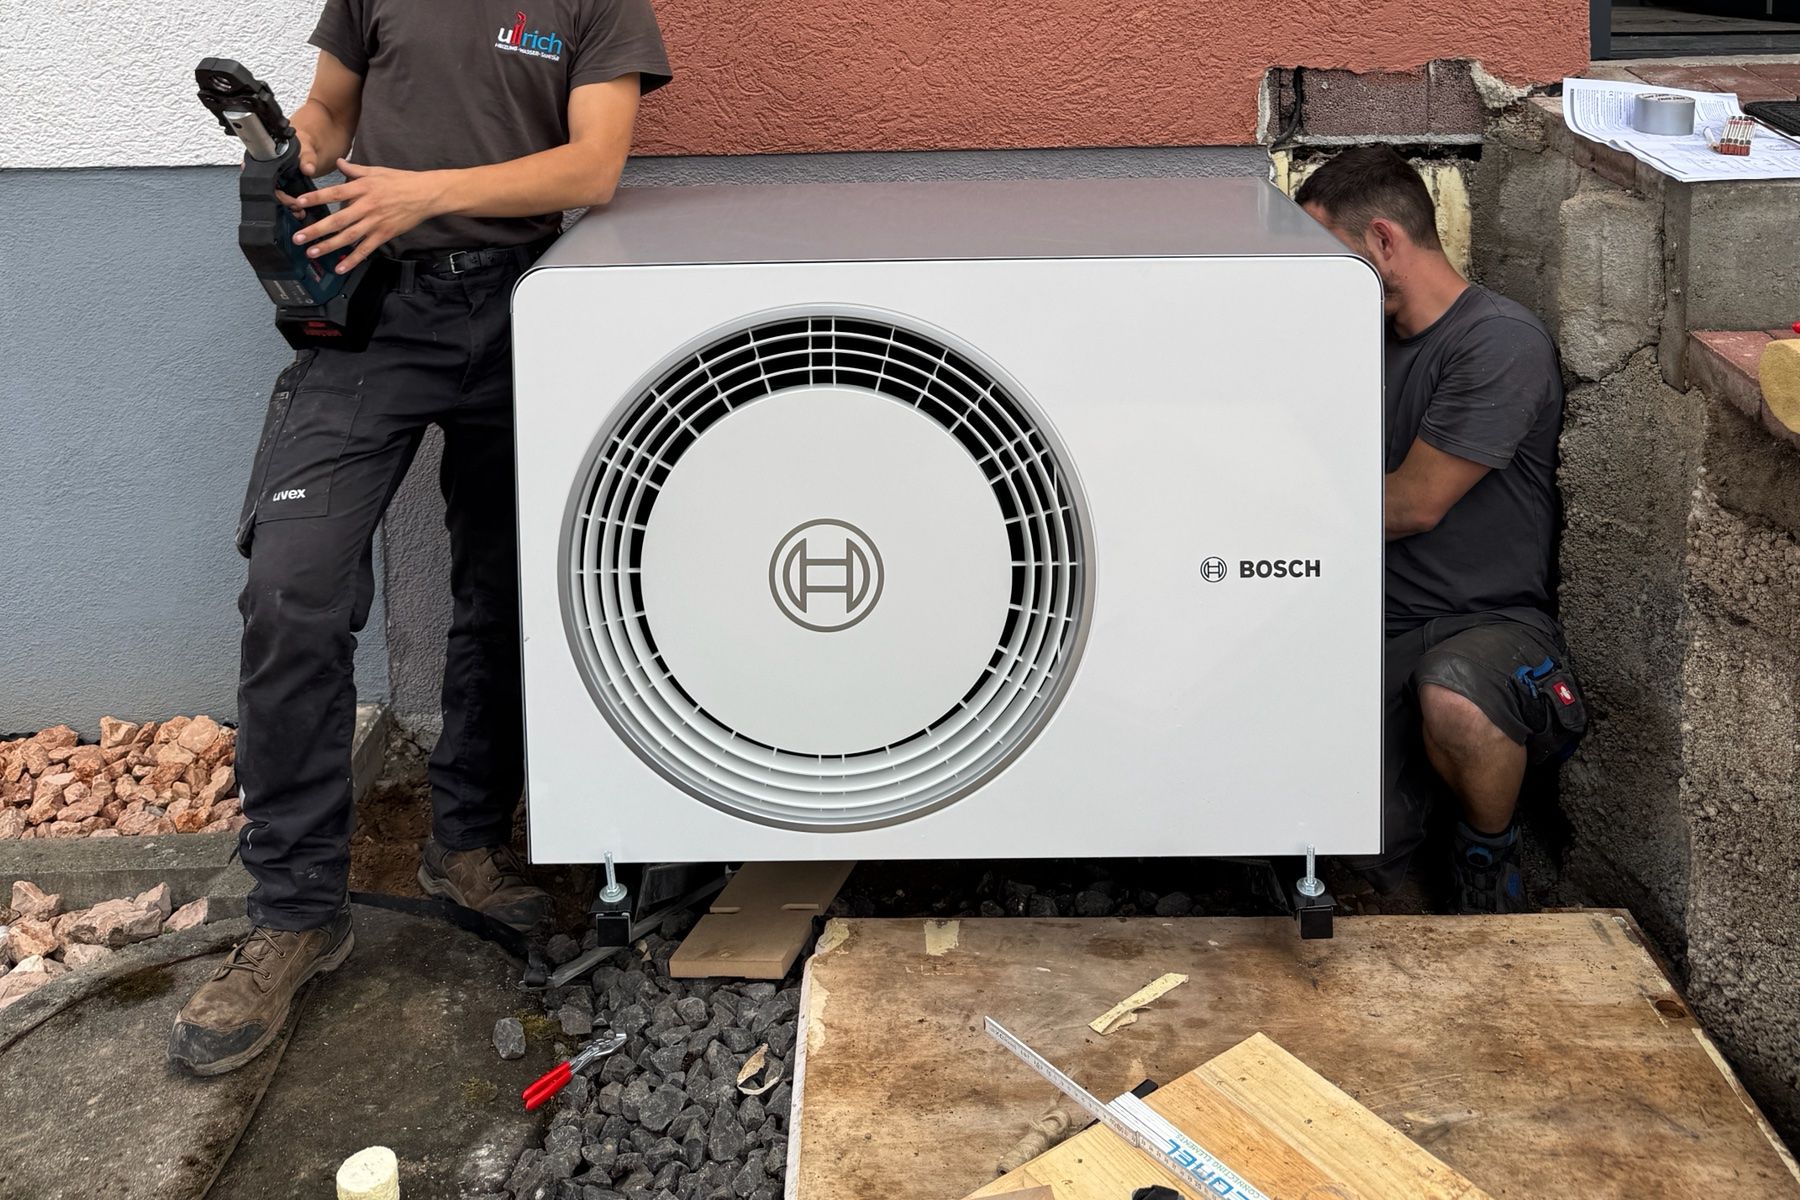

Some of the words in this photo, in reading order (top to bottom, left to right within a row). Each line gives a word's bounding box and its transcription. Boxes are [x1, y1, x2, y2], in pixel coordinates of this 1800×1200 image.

[497, 11, 563, 55] ullrich
[272, 488, 306, 501] uvex
[1239, 559, 1321, 579] BOSCH
[1211, 1161, 1260, 1199] CONNECTING
